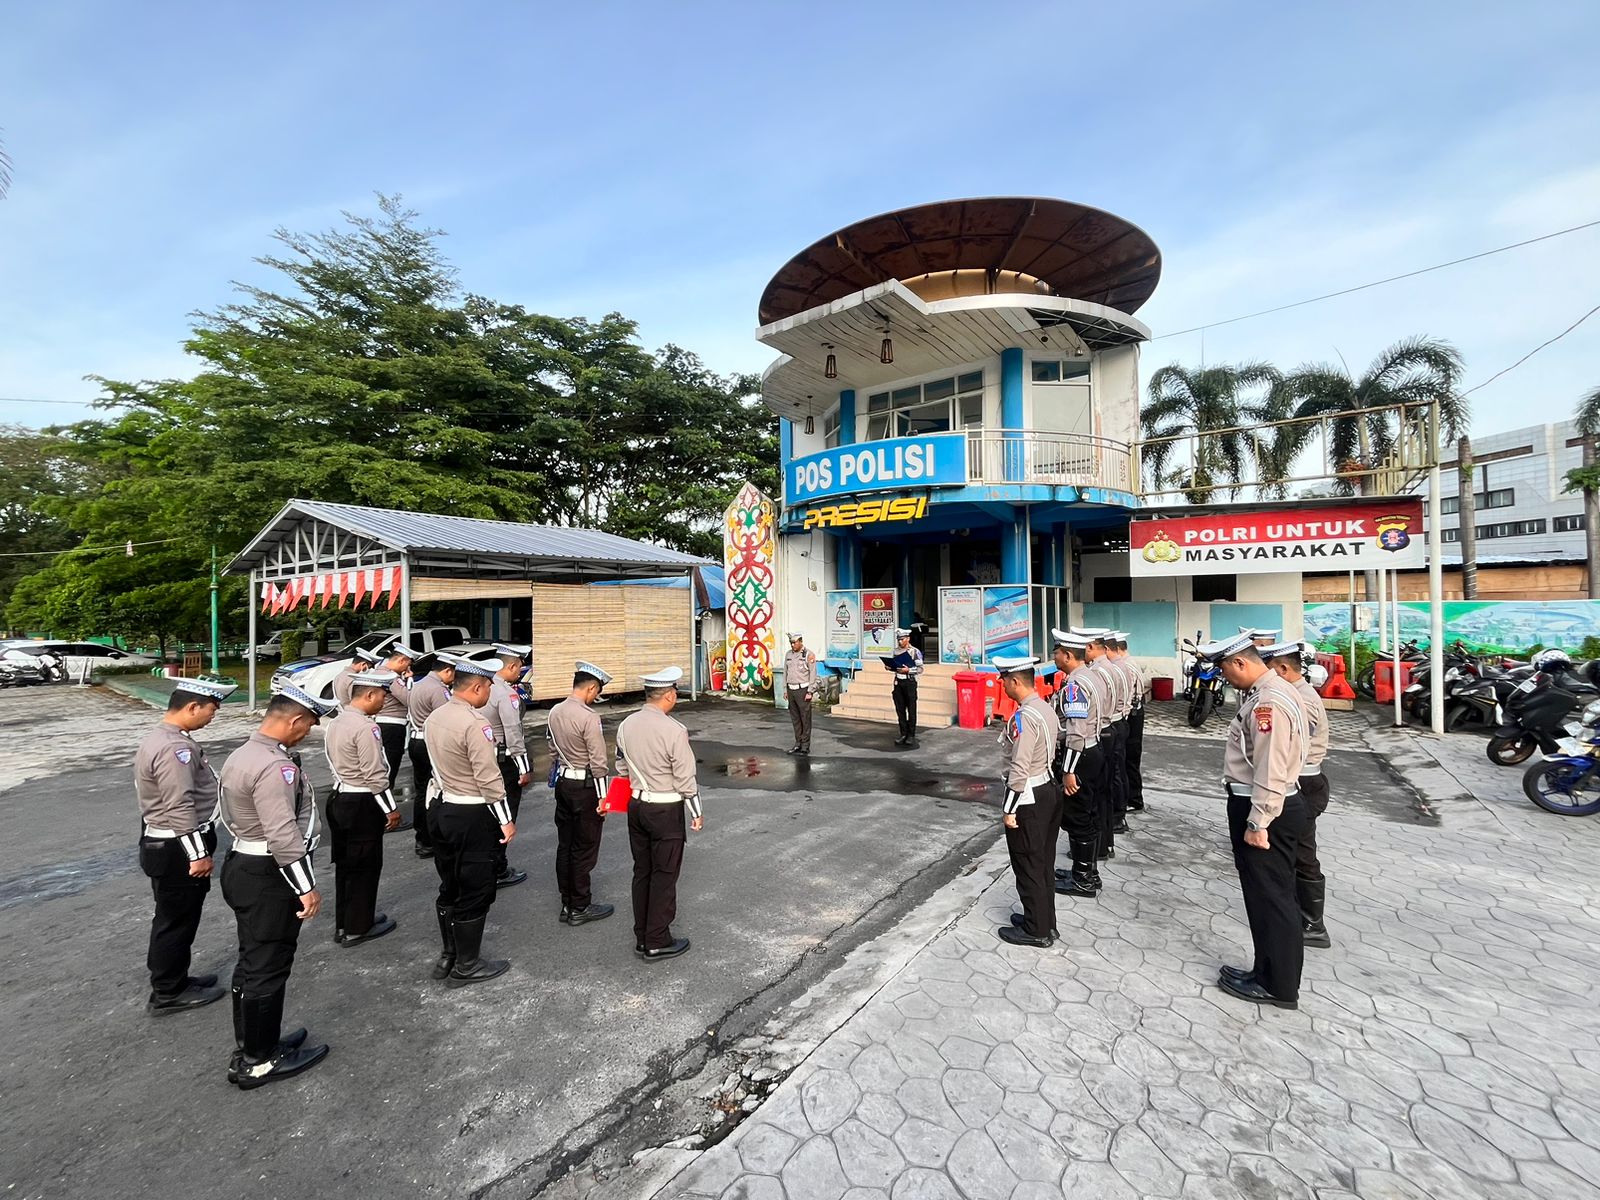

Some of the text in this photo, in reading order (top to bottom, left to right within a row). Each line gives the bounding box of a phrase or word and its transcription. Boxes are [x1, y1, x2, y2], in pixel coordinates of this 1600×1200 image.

[795, 444, 935, 495] POS POLISI
[803, 497, 927, 530] PRESISI
[1184, 519, 1366, 544] POLRI UNTUK
[1185, 541, 1366, 562] MASYARAKAT
